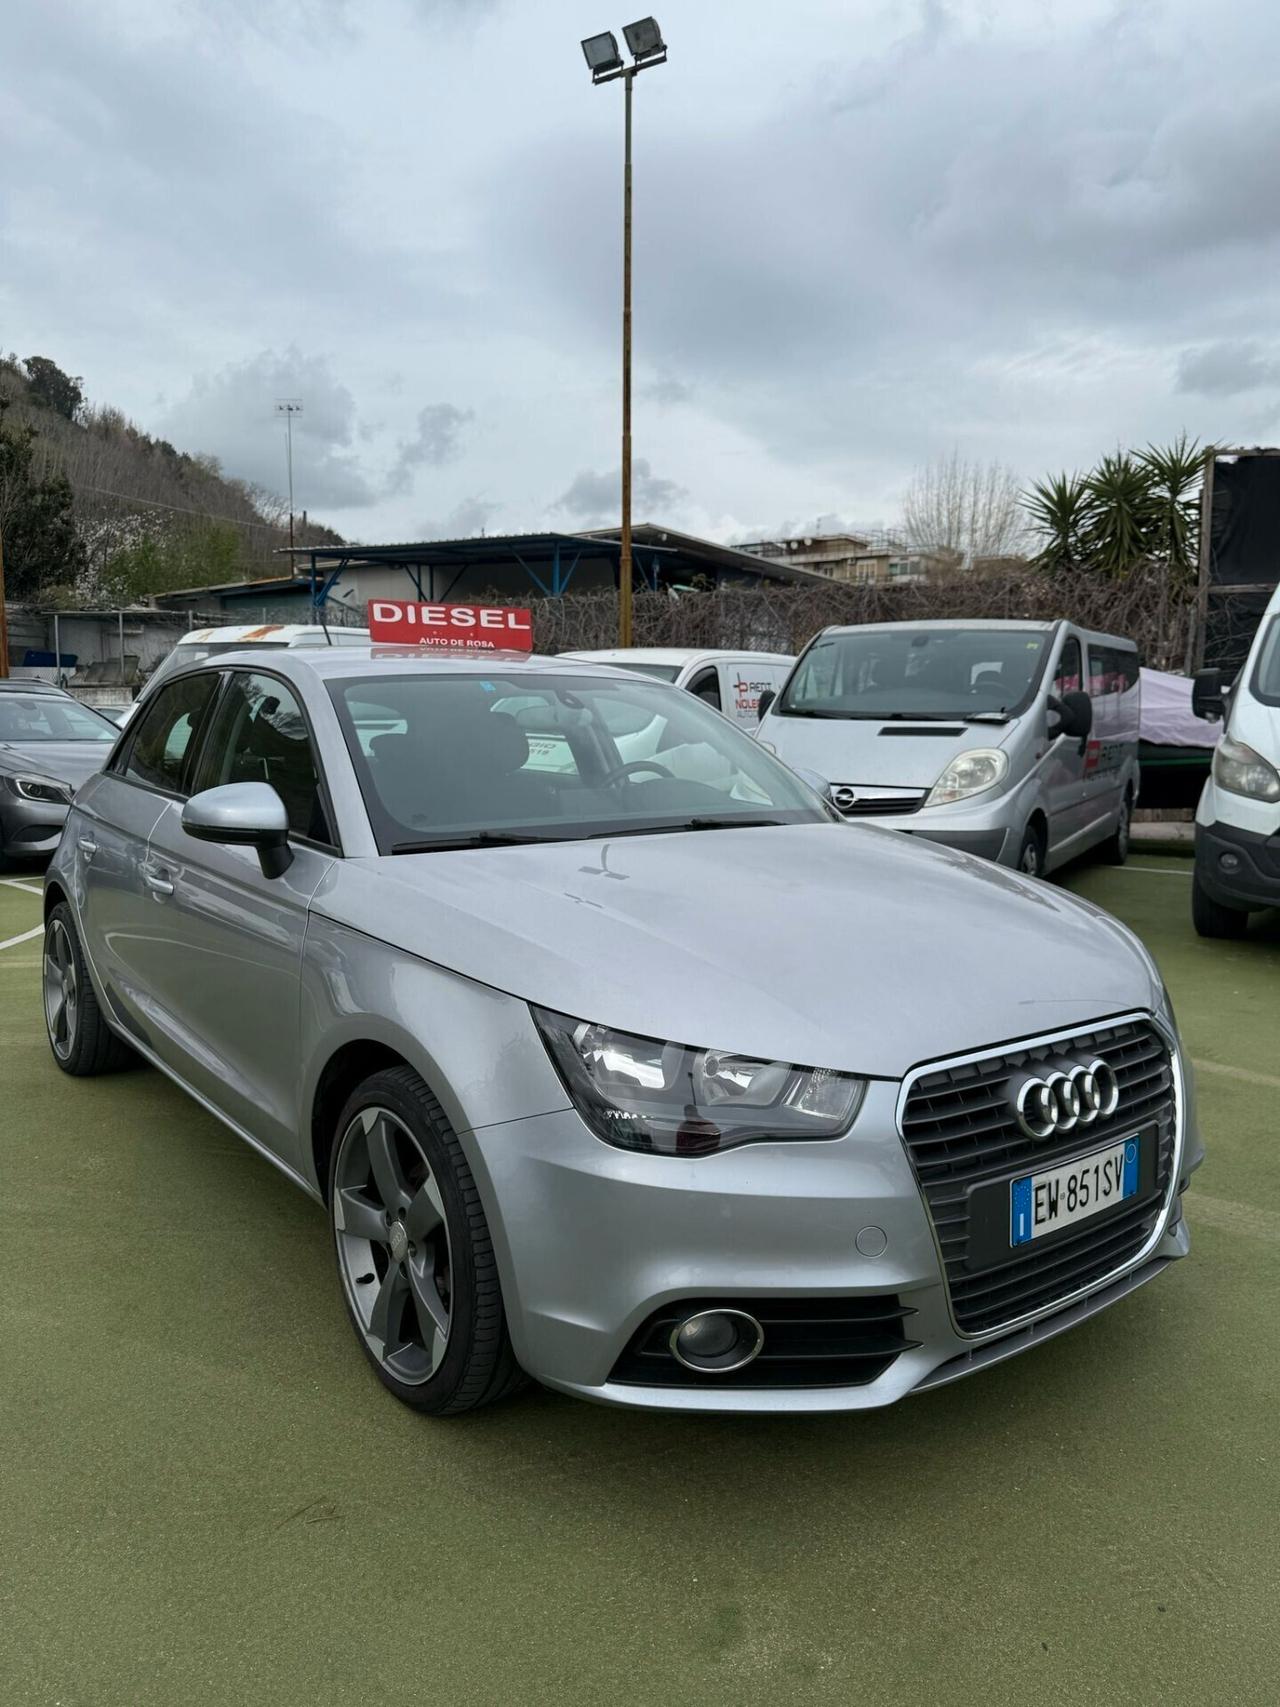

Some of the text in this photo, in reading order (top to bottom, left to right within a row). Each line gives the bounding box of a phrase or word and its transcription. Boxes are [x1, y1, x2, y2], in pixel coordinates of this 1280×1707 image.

[372, 603, 531, 630] DIESEL
[419, 637, 495, 649] AUTO DE ROSA
[735, 699, 760, 710] NOLE
